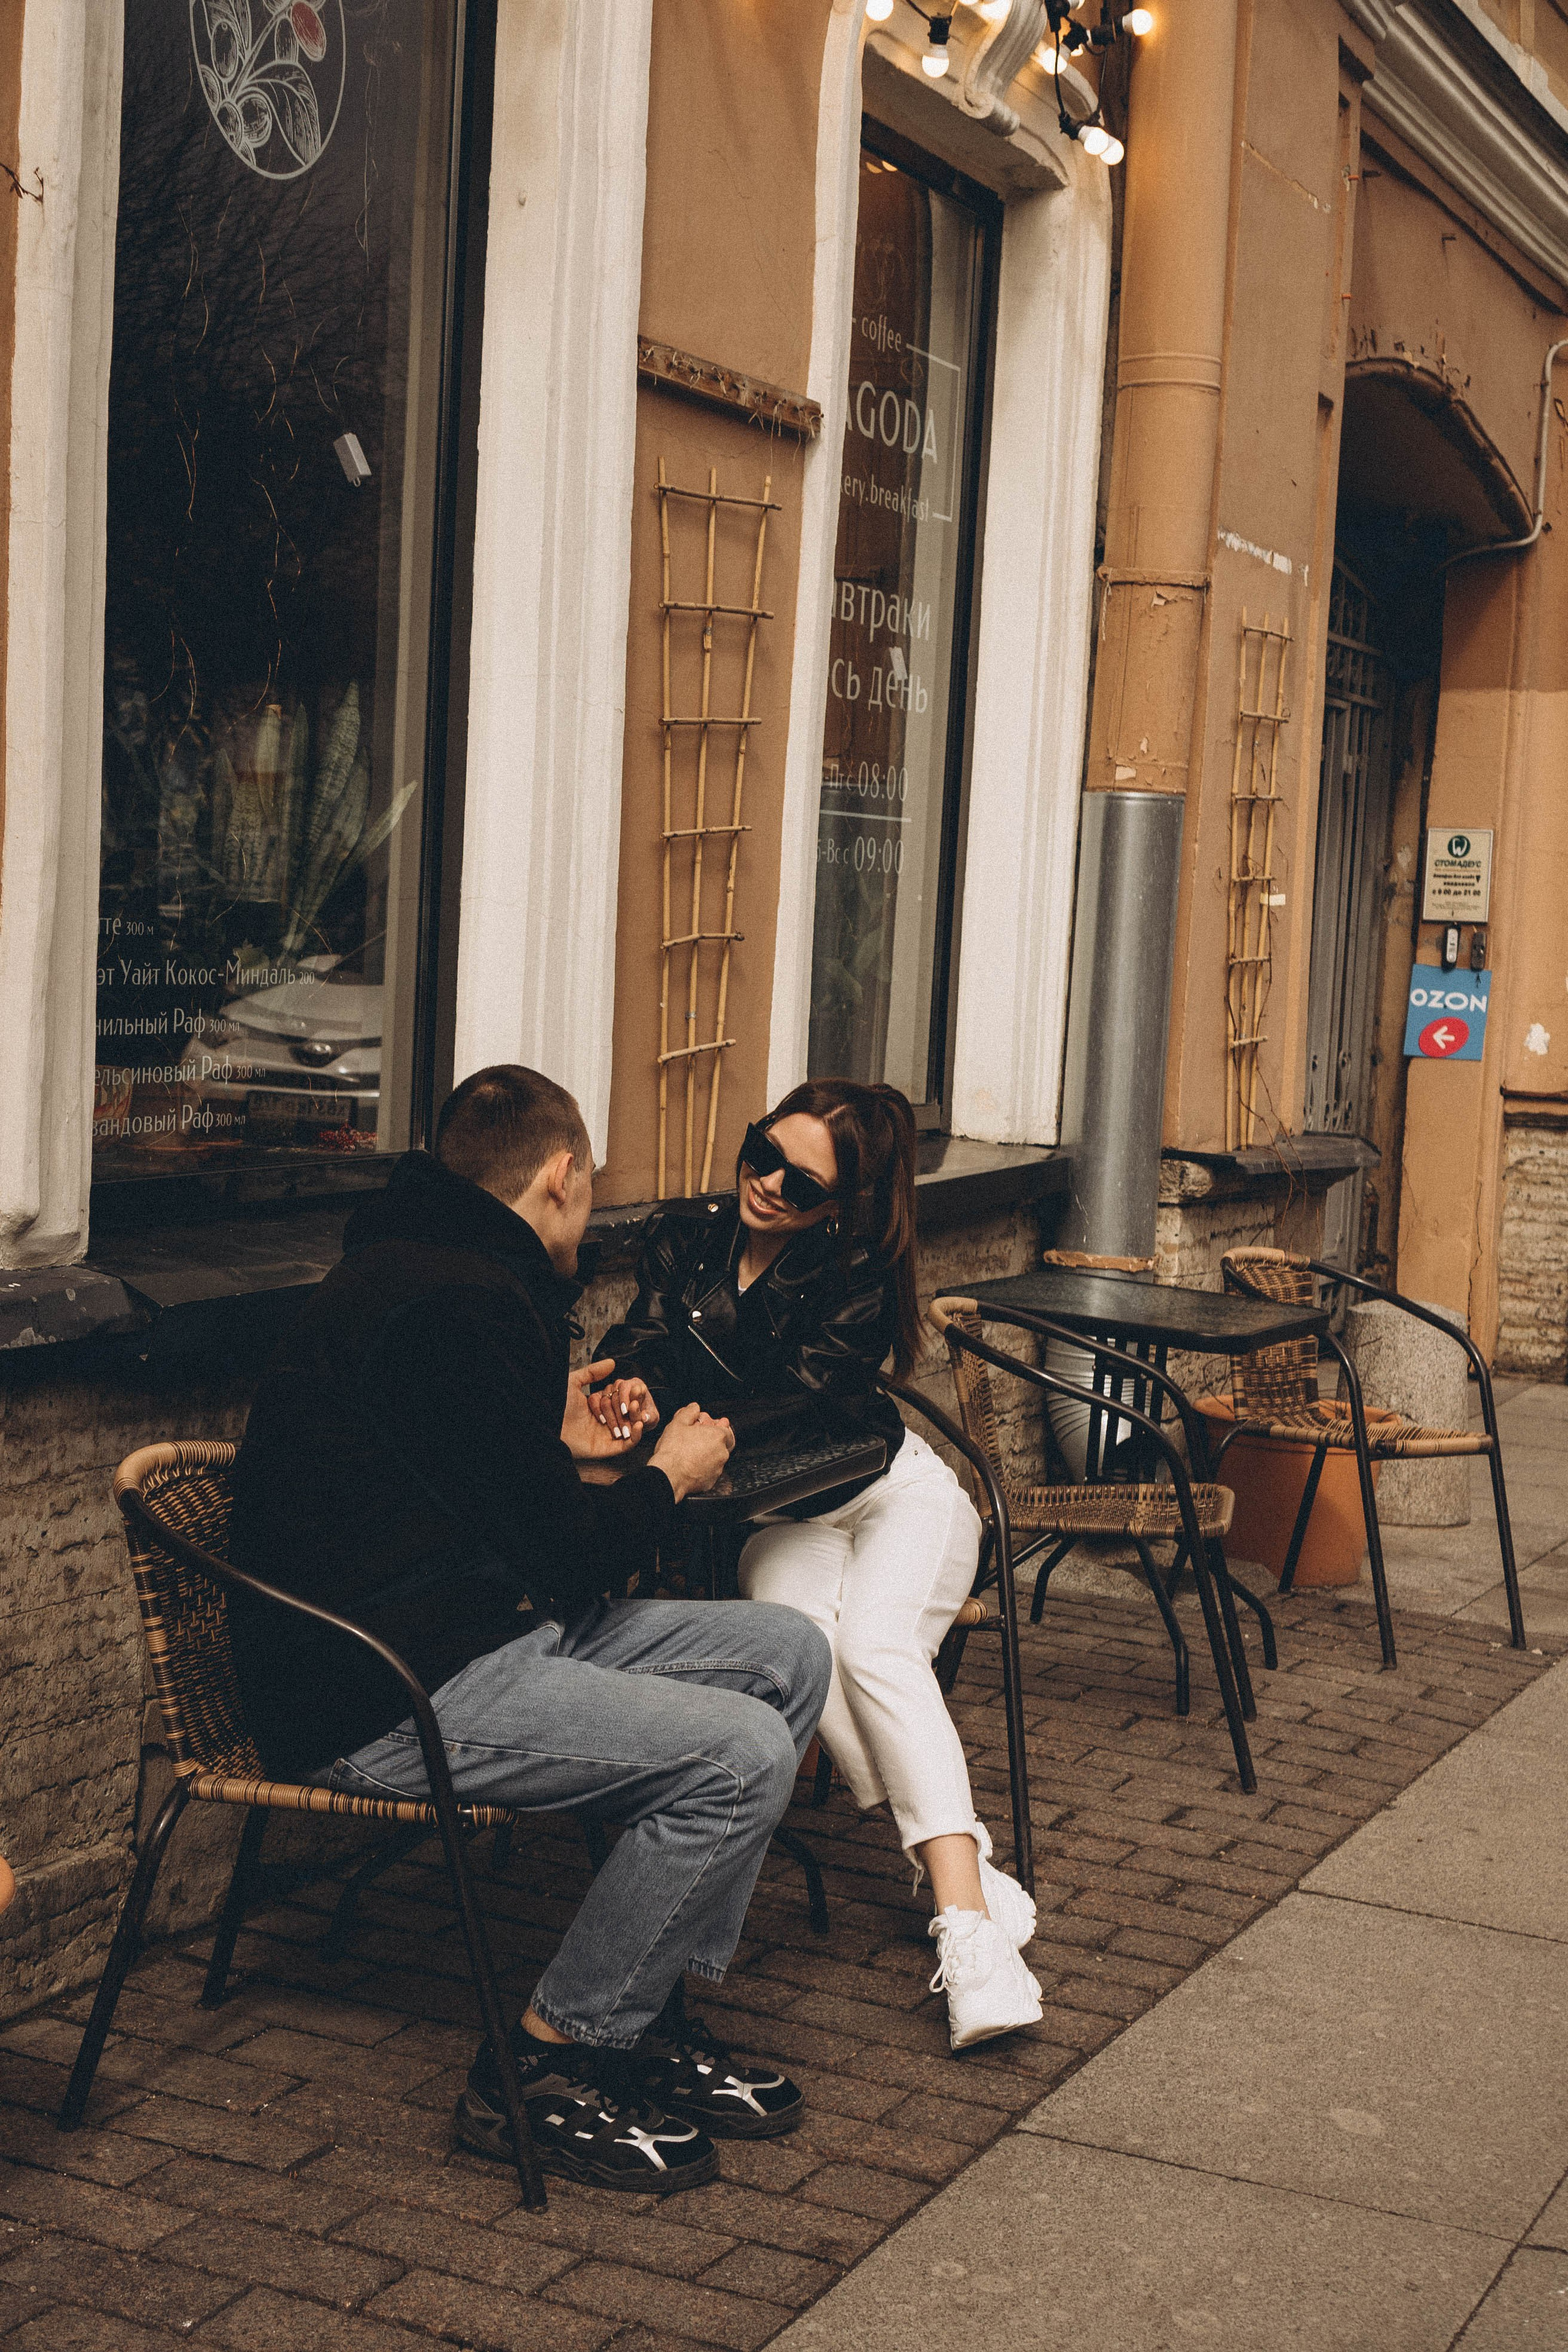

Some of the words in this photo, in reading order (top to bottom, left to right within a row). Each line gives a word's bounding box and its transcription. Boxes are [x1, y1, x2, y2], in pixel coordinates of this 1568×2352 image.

[862, 315, 901, 352] coffee
[841, 474, 929, 522] ery.breakfast
[868, 666, 928, 713] день
[822, 764, 844, 790] -Пт
[859, 761, 908, 801] 08:00
[854, 837, 903, 873] 09:00
[126, 922, 144, 935] 300
[120, 959, 160, 985] Уайт
[166, 959, 296, 987] Кокос-Миндаль
[300, 971, 315, 985] 200
[1410, 989, 1487, 1013] OZON
[173, 1008, 206, 1039] Раф
[209, 1019, 227, 1033] 300
[228, 1022, 240, 1031] мл
[202, 1055, 233, 1085] Раф
[236, 1065, 252, 1079] 300
[255, 1068, 266, 1077] мл
[182, 1104, 213, 1133] Раф
[216, 1113, 232, 1126] 300
[235, 1115, 245, 1125] мл
